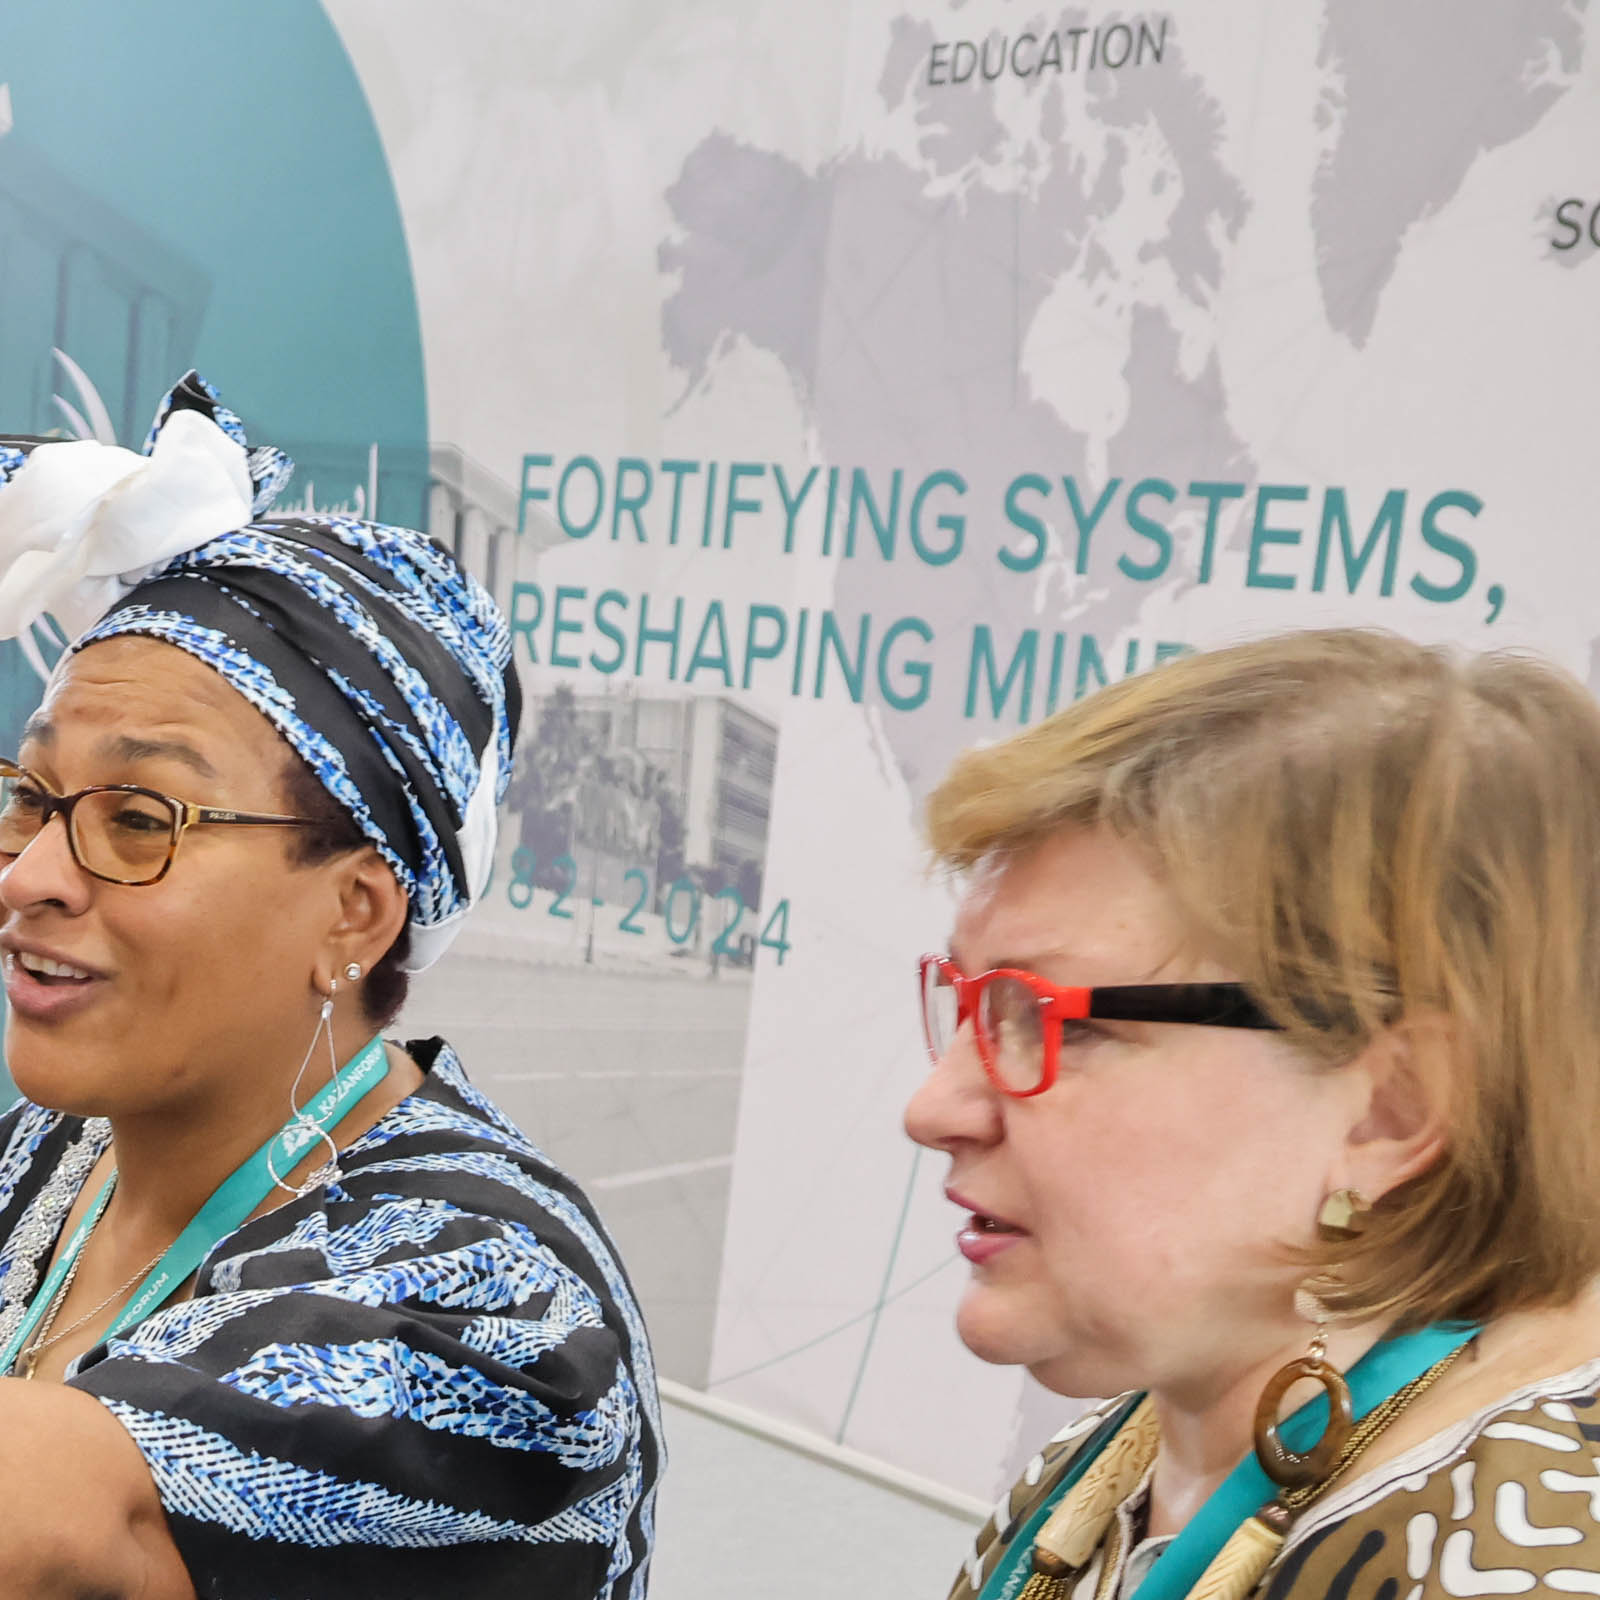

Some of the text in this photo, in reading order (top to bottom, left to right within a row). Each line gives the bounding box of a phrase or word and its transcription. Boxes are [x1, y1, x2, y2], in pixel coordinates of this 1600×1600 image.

[928, 18, 1168, 86] EDUCATION
[1551, 198, 1600, 250] S
[517, 454, 968, 567] FORTIFYING
[998, 472, 1506, 625] SYSTEMS,
[511, 581, 934, 713] RESHAPING
[481, 846, 792, 966] 82-2024
